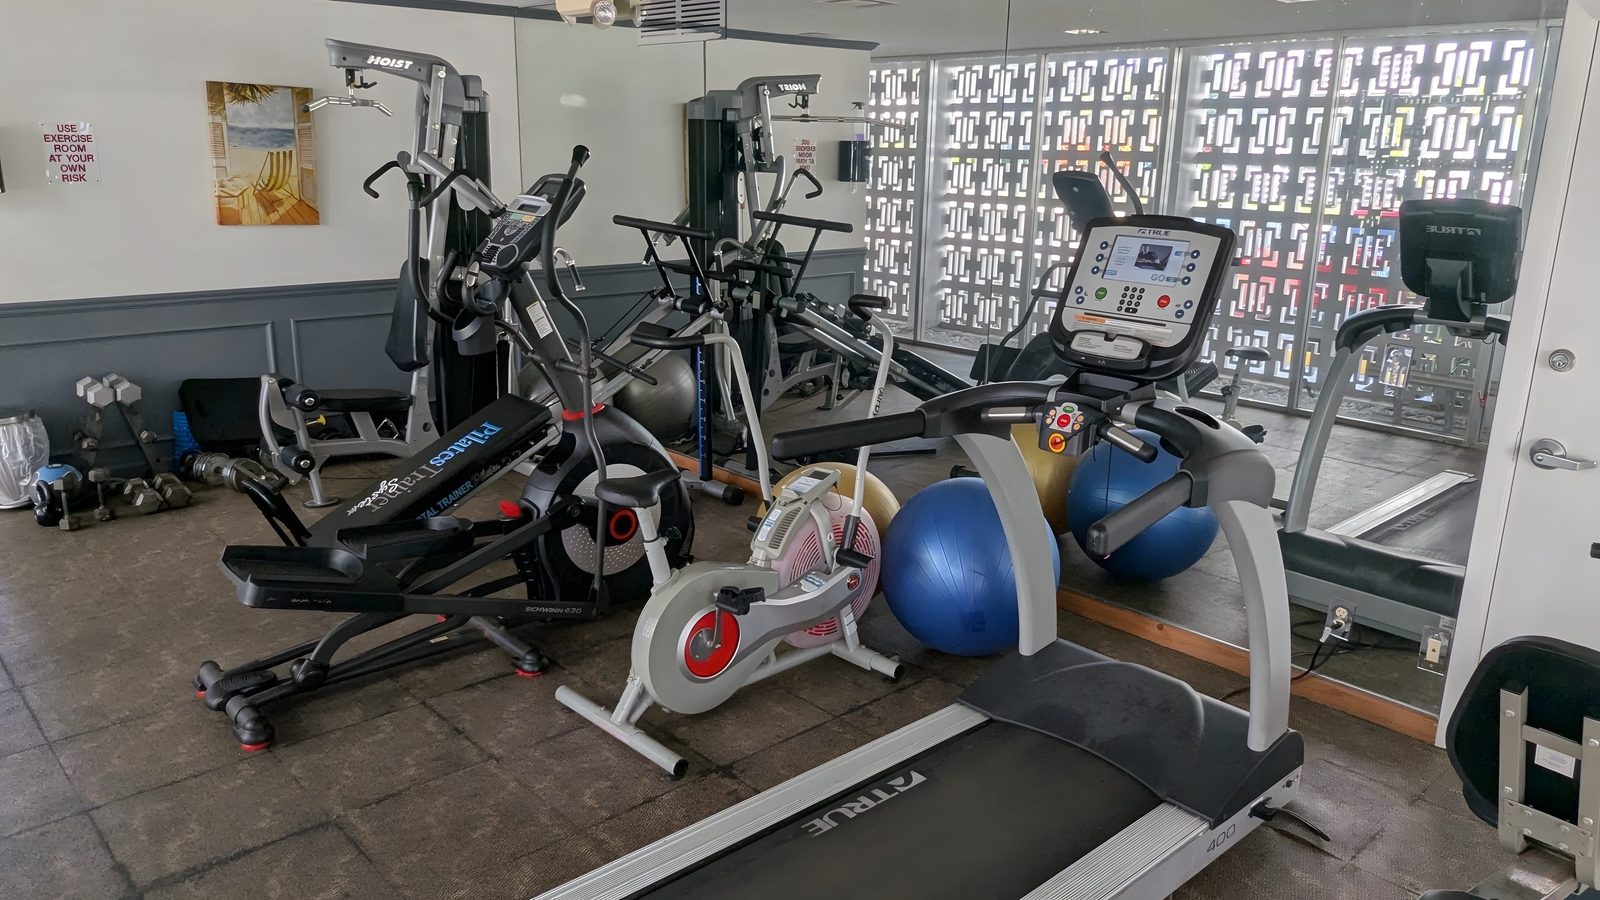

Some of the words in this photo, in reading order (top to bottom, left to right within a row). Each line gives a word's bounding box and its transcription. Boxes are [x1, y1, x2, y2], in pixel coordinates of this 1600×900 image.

[366, 55, 414, 69] HOIST
[57, 124, 77, 132] USE
[43, 134, 93, 143] EXERCISE
[53, 144, 87, 152] ROOM
[49, 154, 62, 162] AT
[65, 154, 94, 162] YOUR
[60, 164, 86, 172] OWN
[61, 174, 87, 182] RISK
[1148, 229, 1172, 237] TRUE
[430, 421, 503, 467] Pilates
[436, 480, 474, 510] TRAINER
[800, 788, 900, 838] TRUE
[1207, 823, 1236, 853] 400
